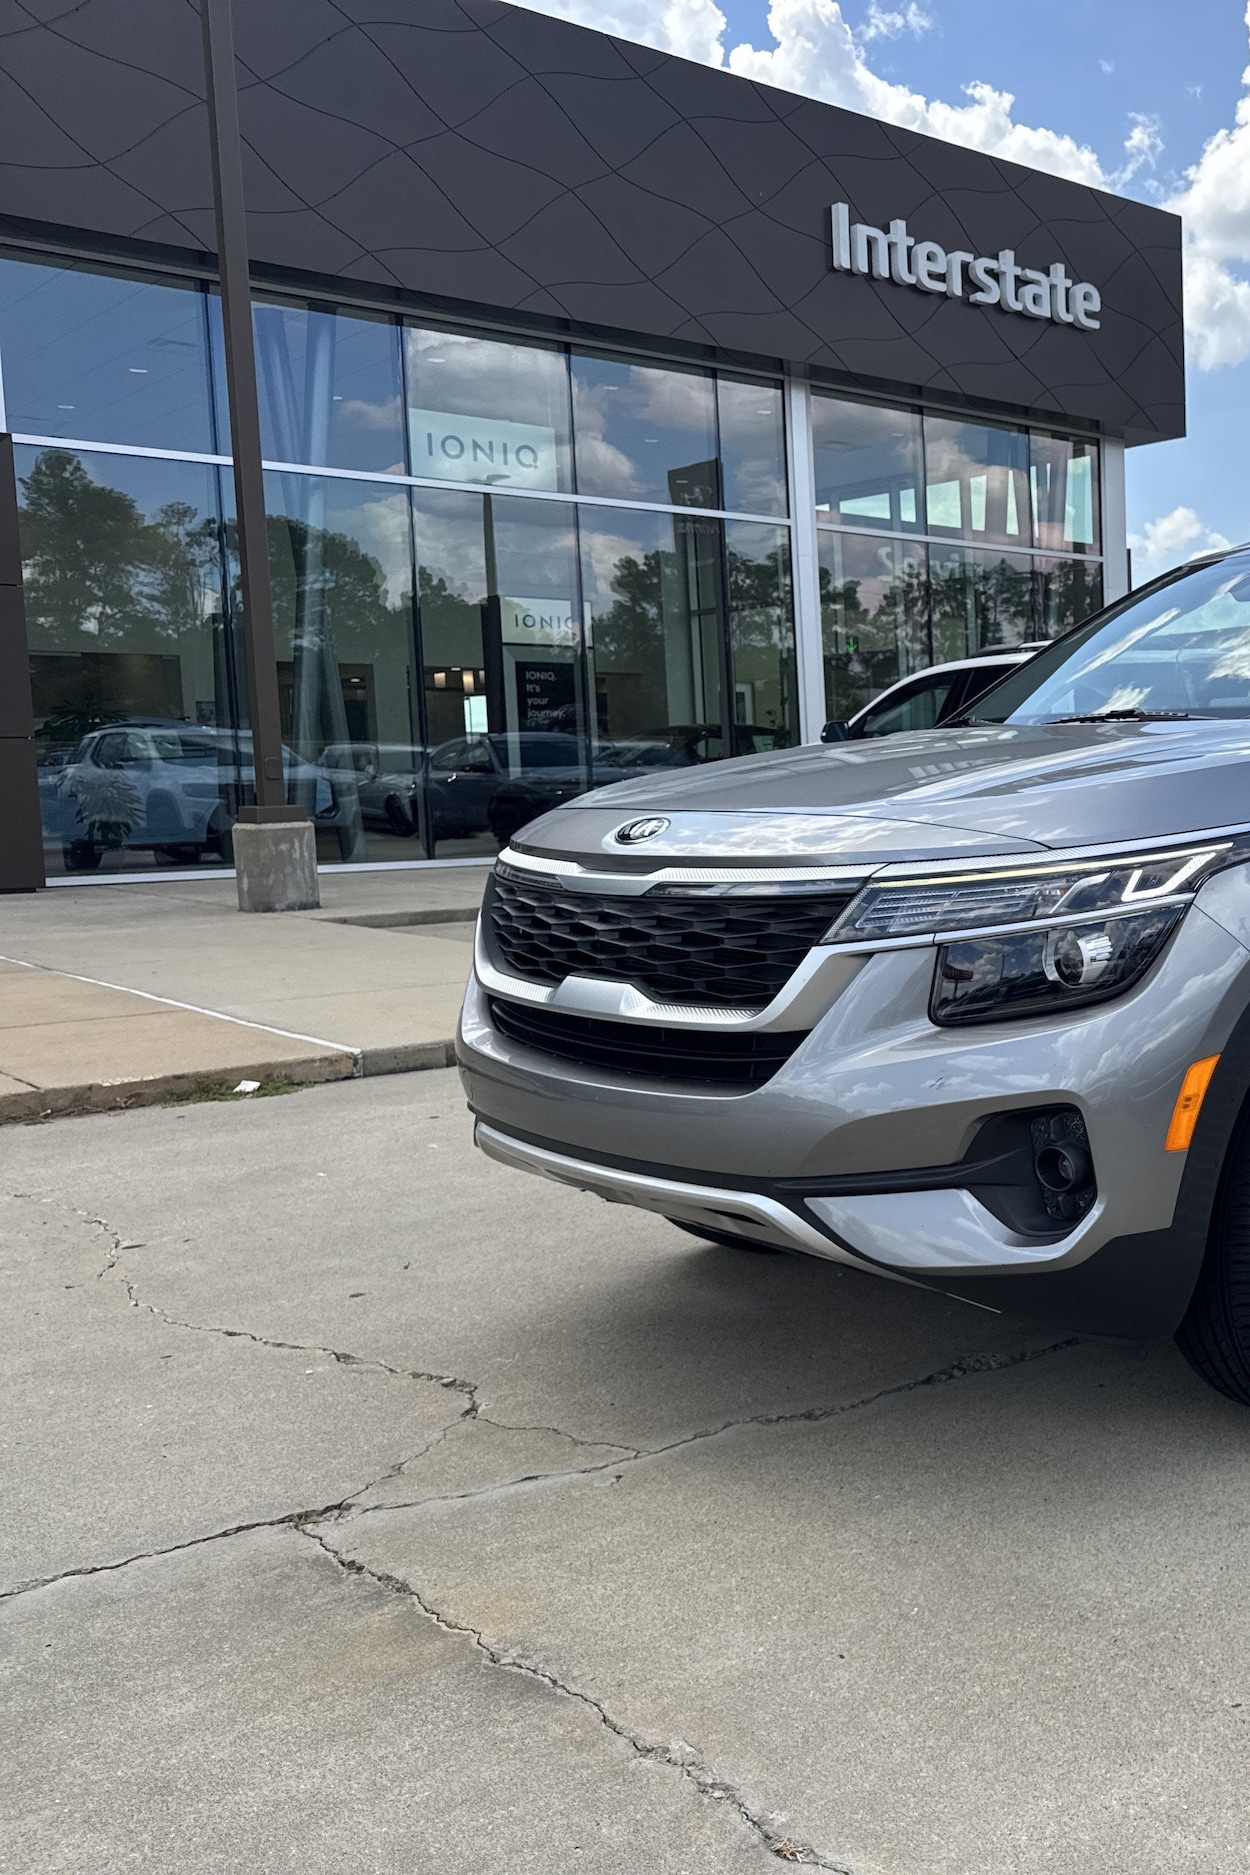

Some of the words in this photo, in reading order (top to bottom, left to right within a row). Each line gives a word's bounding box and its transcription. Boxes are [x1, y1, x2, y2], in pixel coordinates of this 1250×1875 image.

[830, 202, 1101, 330] Interstate
[427, 432, 538, 470] IONIQ
[525, 671, 558, 682] IONIQ.
[527, 697, 549, 707] your
